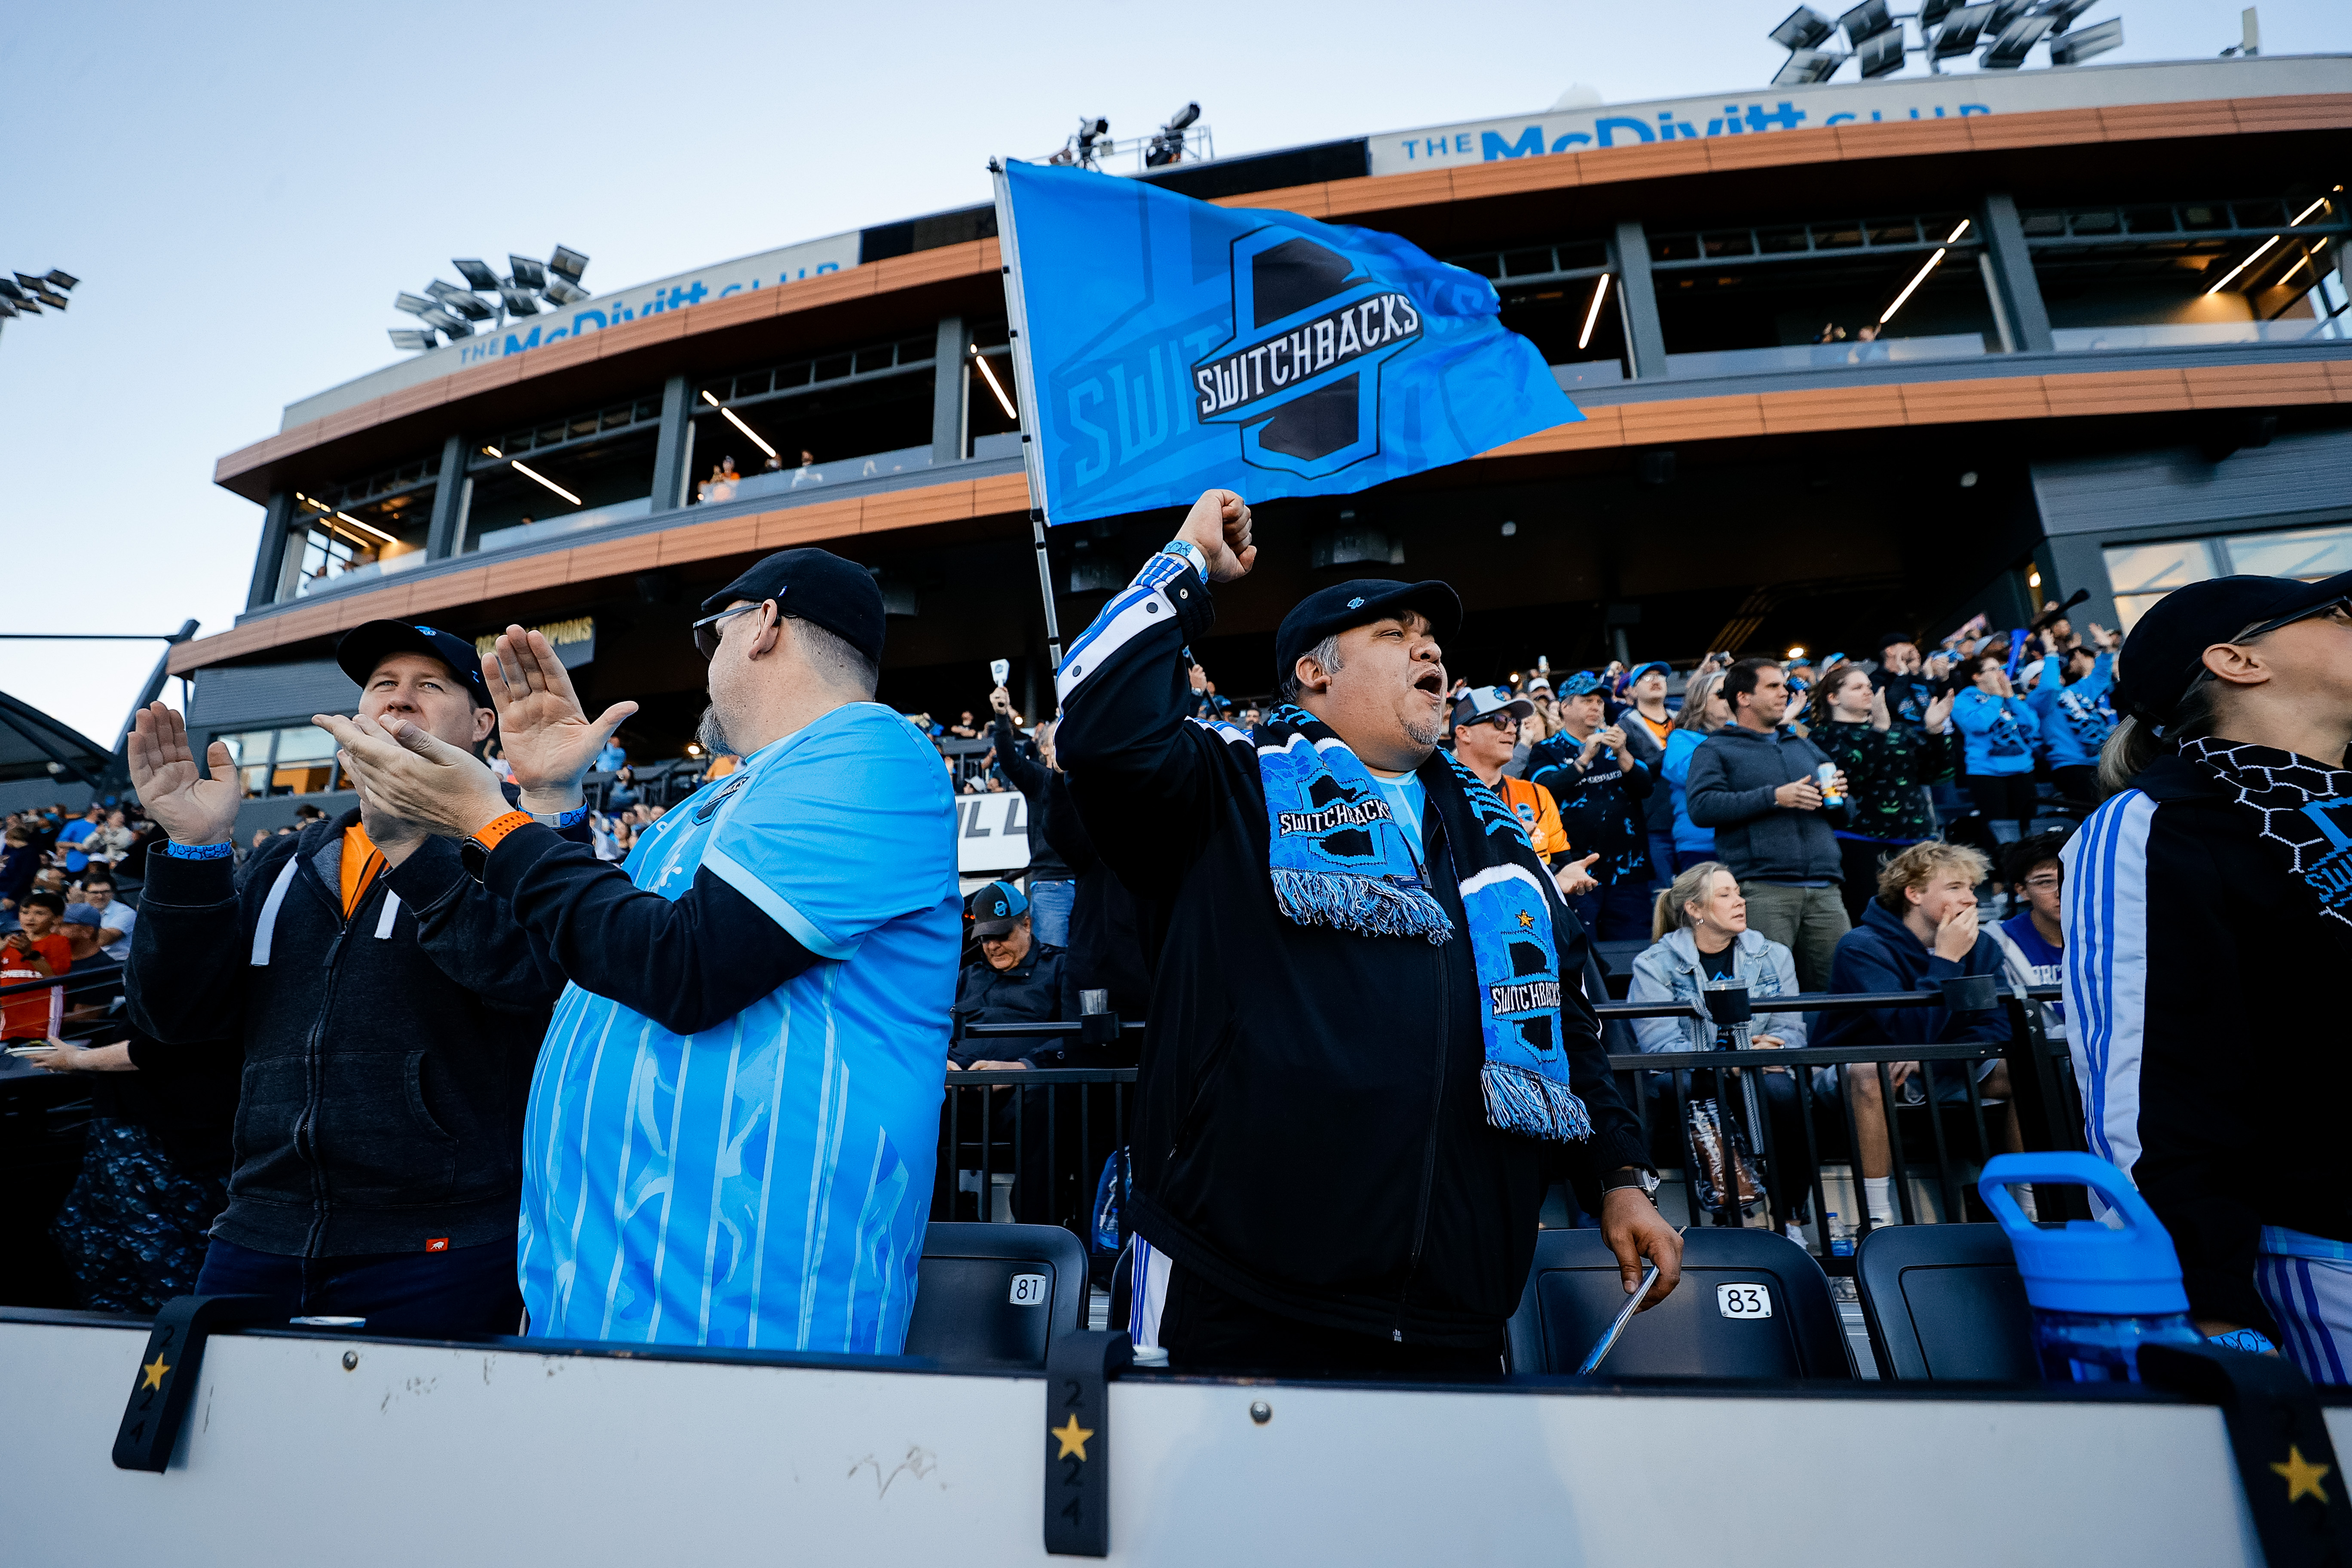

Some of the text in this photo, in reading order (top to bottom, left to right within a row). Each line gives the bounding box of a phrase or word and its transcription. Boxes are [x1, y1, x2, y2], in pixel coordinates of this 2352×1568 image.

[1402, 132, 1472, 159] THE
[461, 337, 499, 364] THE
[1197, 294, 1418, 414] SWITCHBACKS
[1280, 799, 1393, 835] SWITCHBACKS
[1017, 1279, 1038, 1300] 81
[1728, 1289, 1761, 1313] 83
